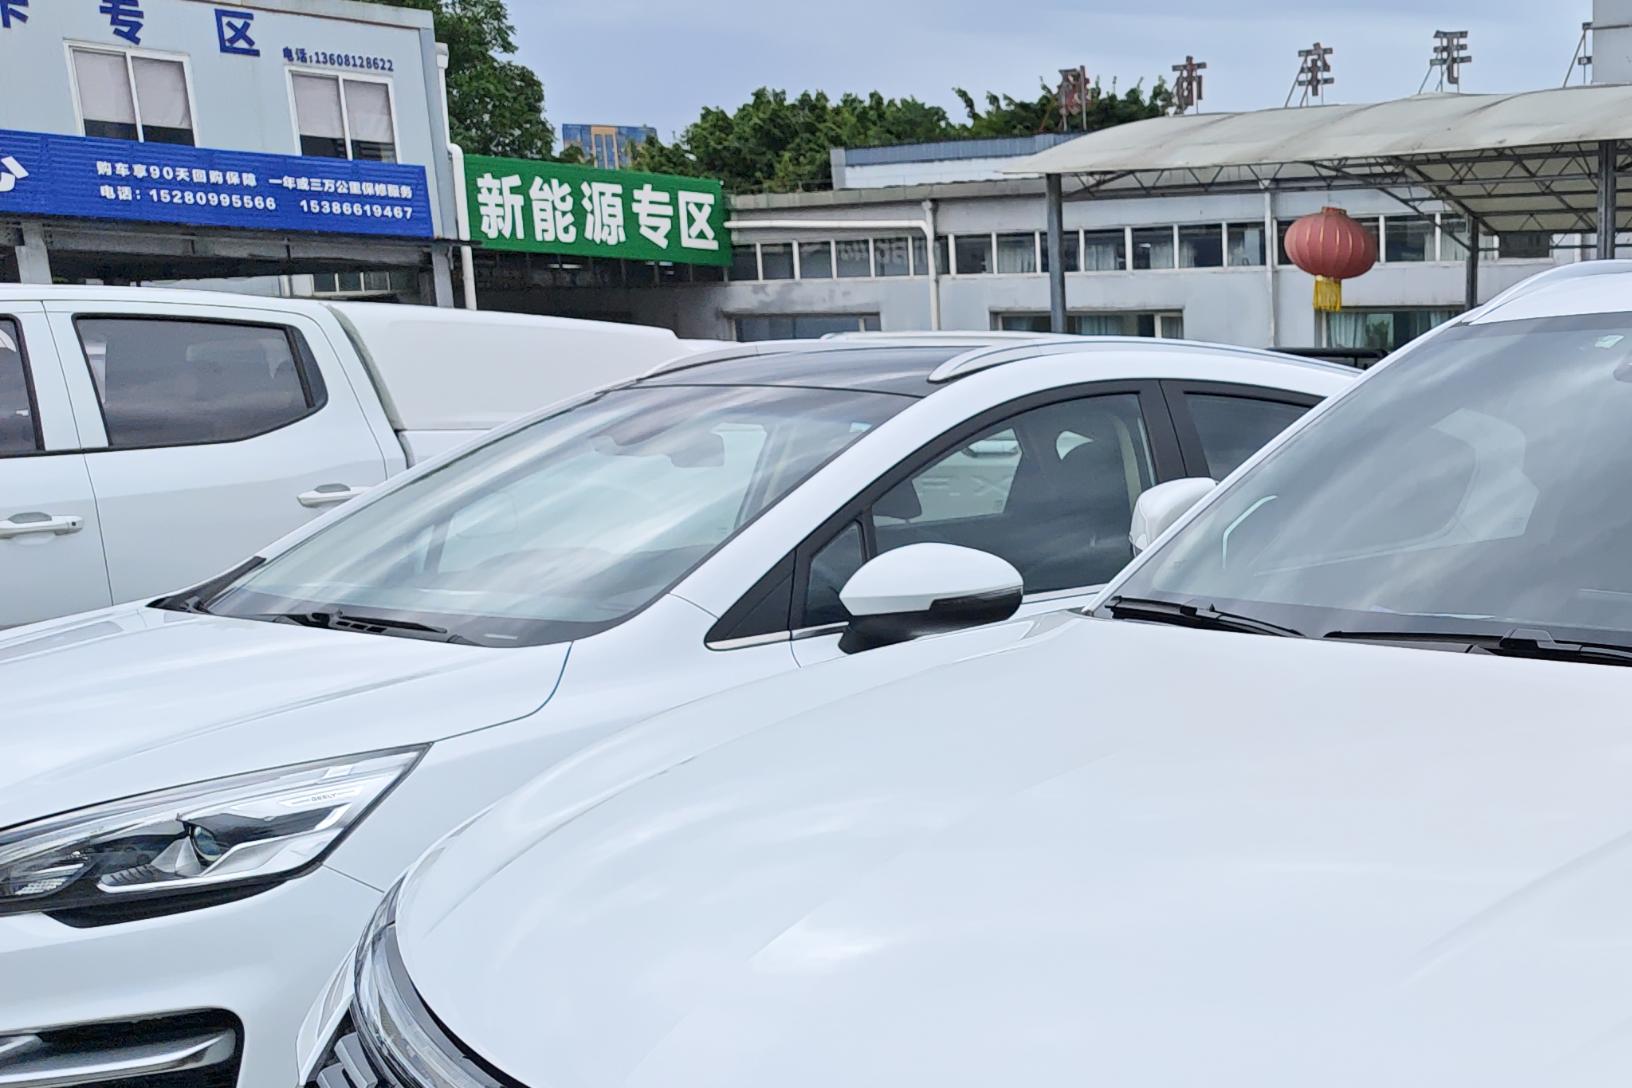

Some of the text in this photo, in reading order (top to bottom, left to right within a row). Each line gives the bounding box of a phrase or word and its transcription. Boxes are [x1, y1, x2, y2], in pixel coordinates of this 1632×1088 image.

[96, 161, 257, 187] 购车享90天回购保障
[300, 200, 413, 219] 15386619467
[476, 173, 719, 250] 新能源专区
